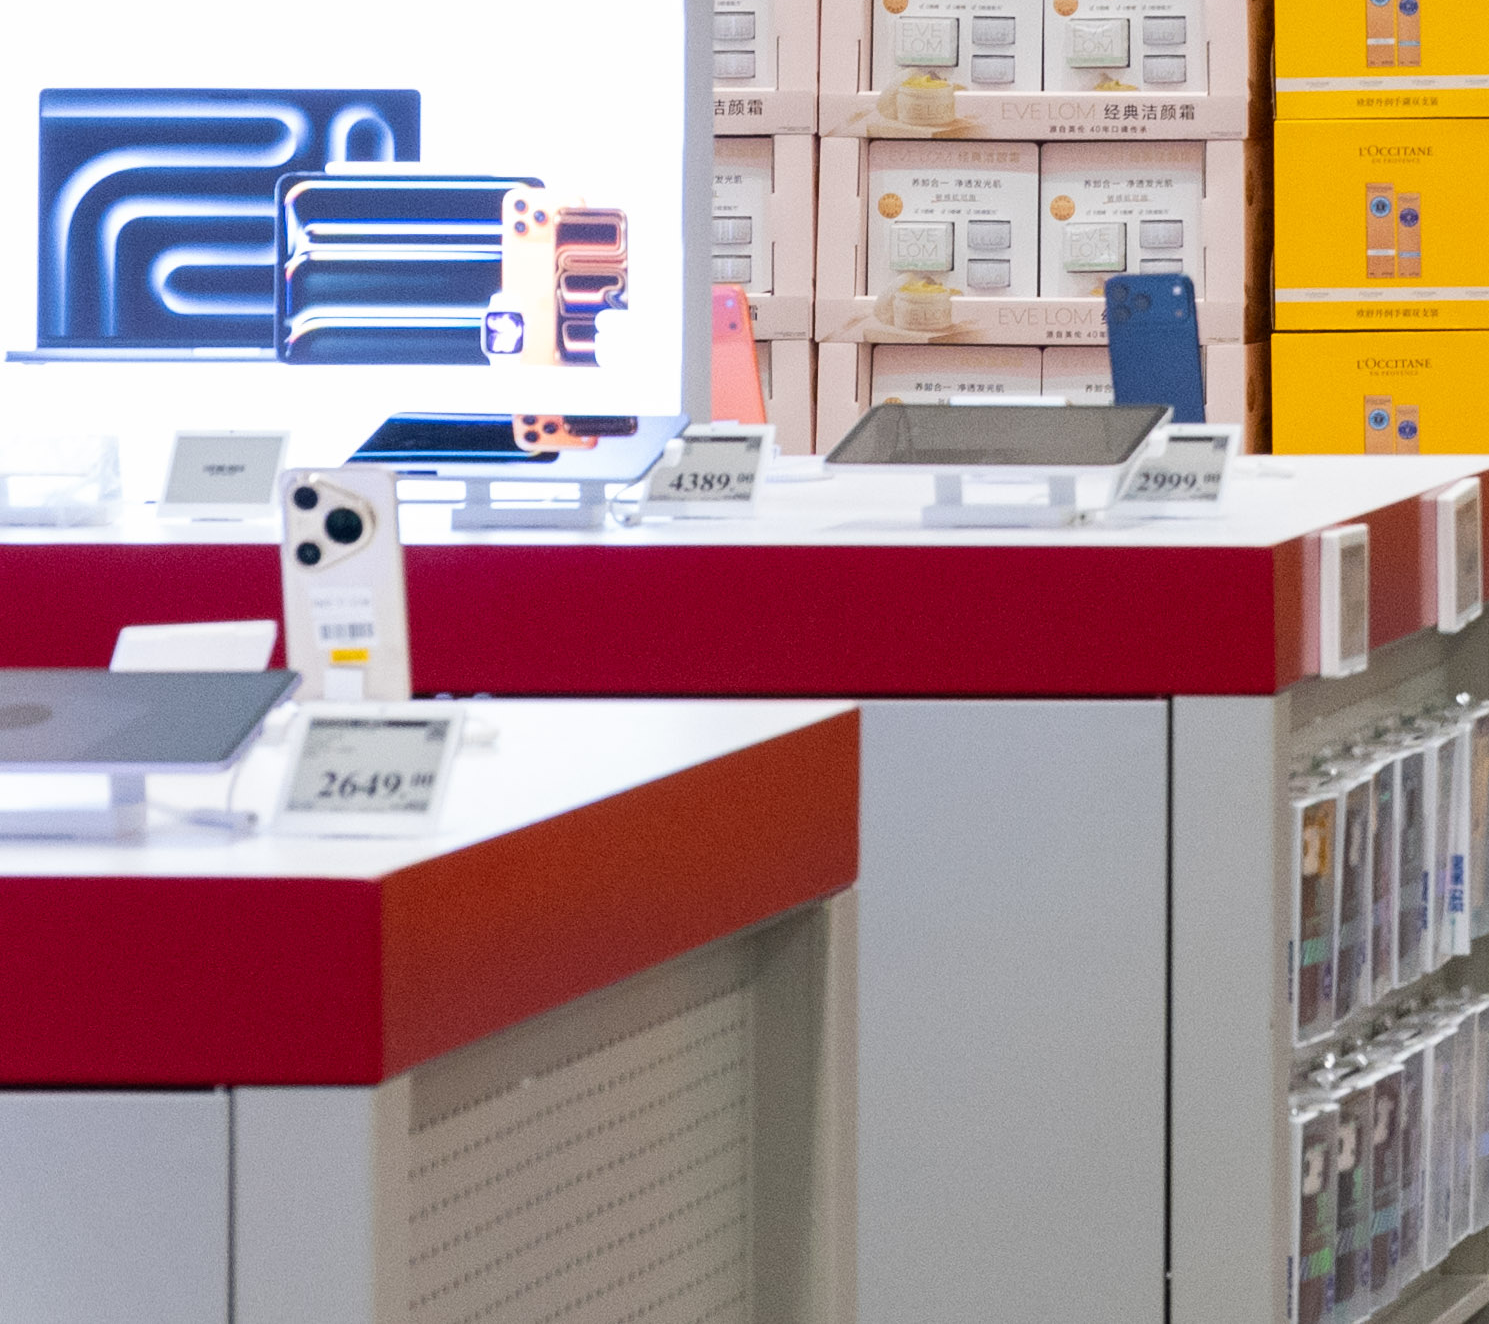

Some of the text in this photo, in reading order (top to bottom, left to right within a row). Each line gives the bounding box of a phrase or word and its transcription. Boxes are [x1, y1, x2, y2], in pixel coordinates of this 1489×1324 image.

[668, 472, 756, 492] 4389.00
[1135, 471, 1222, 493] 2999.00
[317, 770, 434, 800] 2649.00
